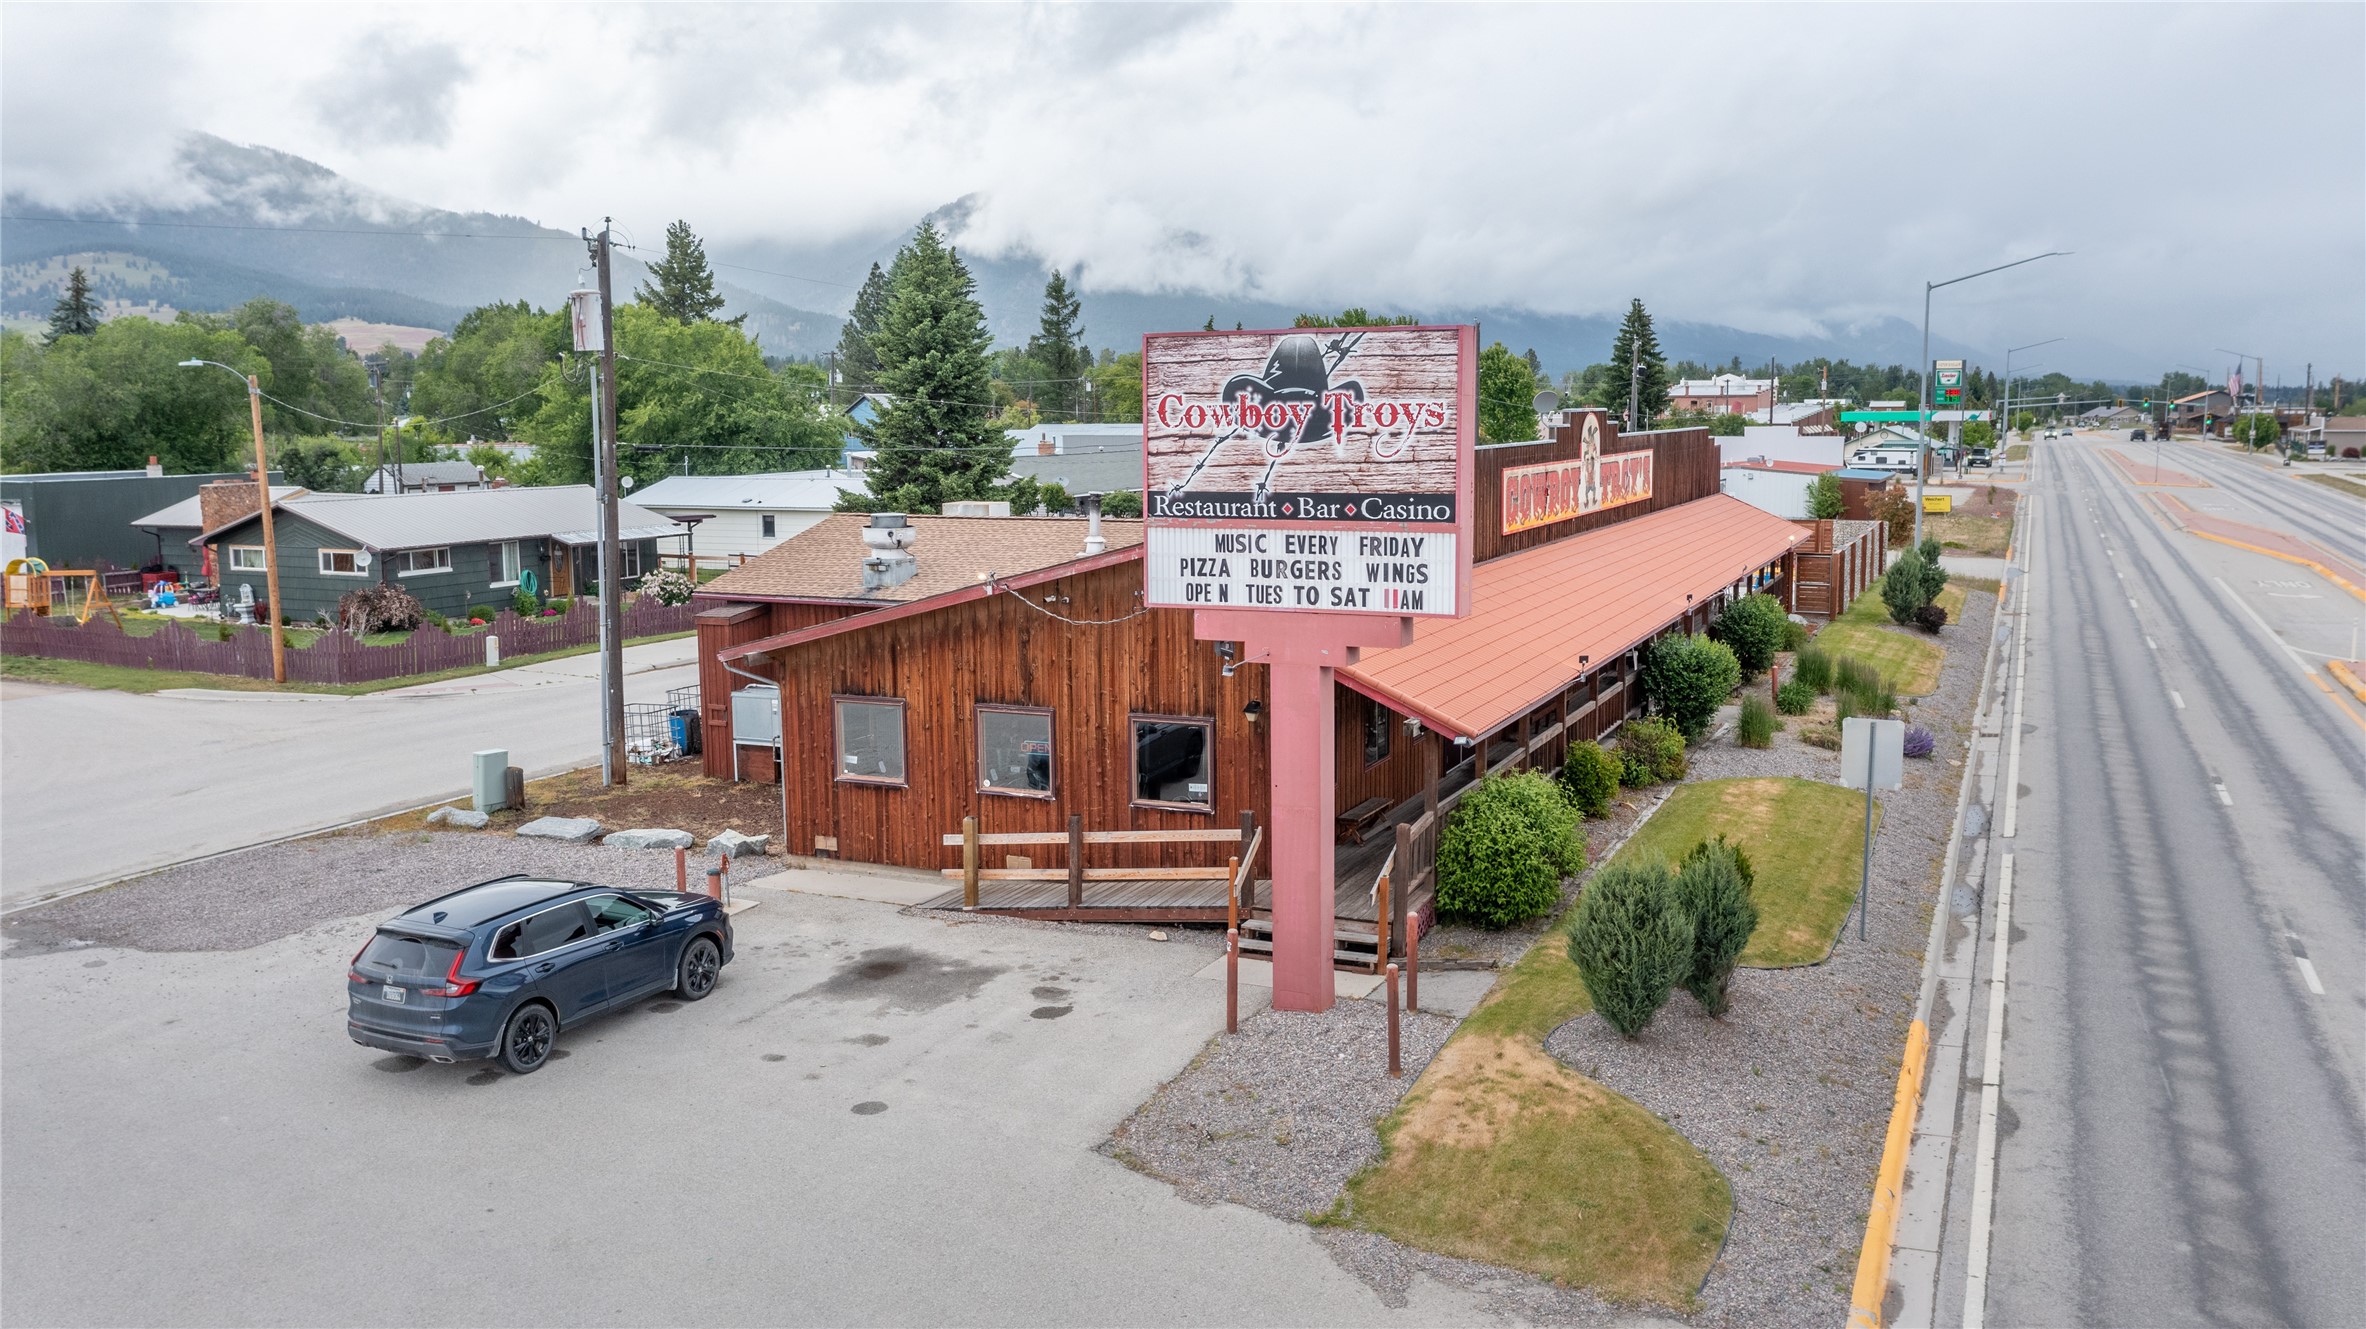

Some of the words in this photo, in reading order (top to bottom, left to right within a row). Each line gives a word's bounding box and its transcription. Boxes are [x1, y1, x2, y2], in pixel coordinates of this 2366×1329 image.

[1157, 394, 1313, 458] Cowboy
[1324, 393, 1445, 458] Troys
[1505, 467, 1581, 527] COWBOY
[1601, 455, 1651, 504] TROY'S
[1154, 495, 1277, 518] Restaurant
[1298, 498, 1340, 519] Bar
[1361, 497, 1451, 521] Casino
[1215, 533, 1267, 554] MUSIC
[1285, 534, 1338, 556] EVERY
[1360, 536, 1424, 558] FRIDAY
[1180, 557, 1231, 578] PIZZA
[1250, 558, 1342, 580] BURGERS
[1366, 562, 1429, 584] WINGS
[1245, 584, 1283, 605] TUES
[1293, 585, 1320, 606] TO
[1330, 586, 1370, 608] SAT
